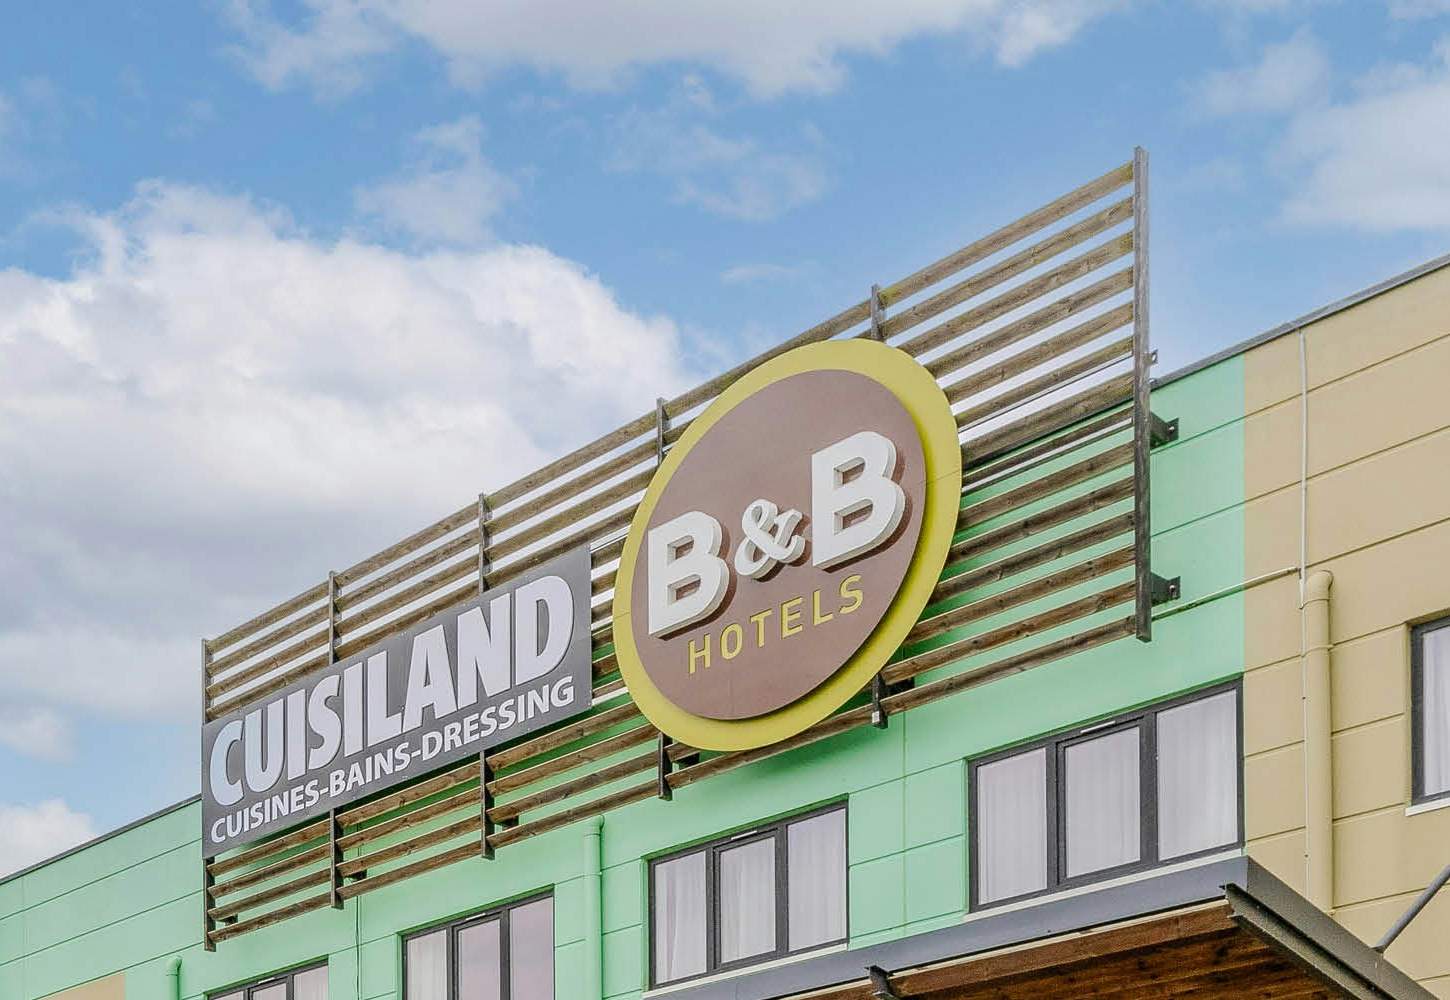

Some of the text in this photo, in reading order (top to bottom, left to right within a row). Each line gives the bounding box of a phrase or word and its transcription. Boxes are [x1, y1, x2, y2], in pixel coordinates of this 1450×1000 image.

[648, 430, 908, 637] B&B
[687, 574, 865, 675] HOTELS
[209, 575, 575, 807] CUISILAND
[210, 675, 576, 844] CUISINES-BAINS-DRESSING
